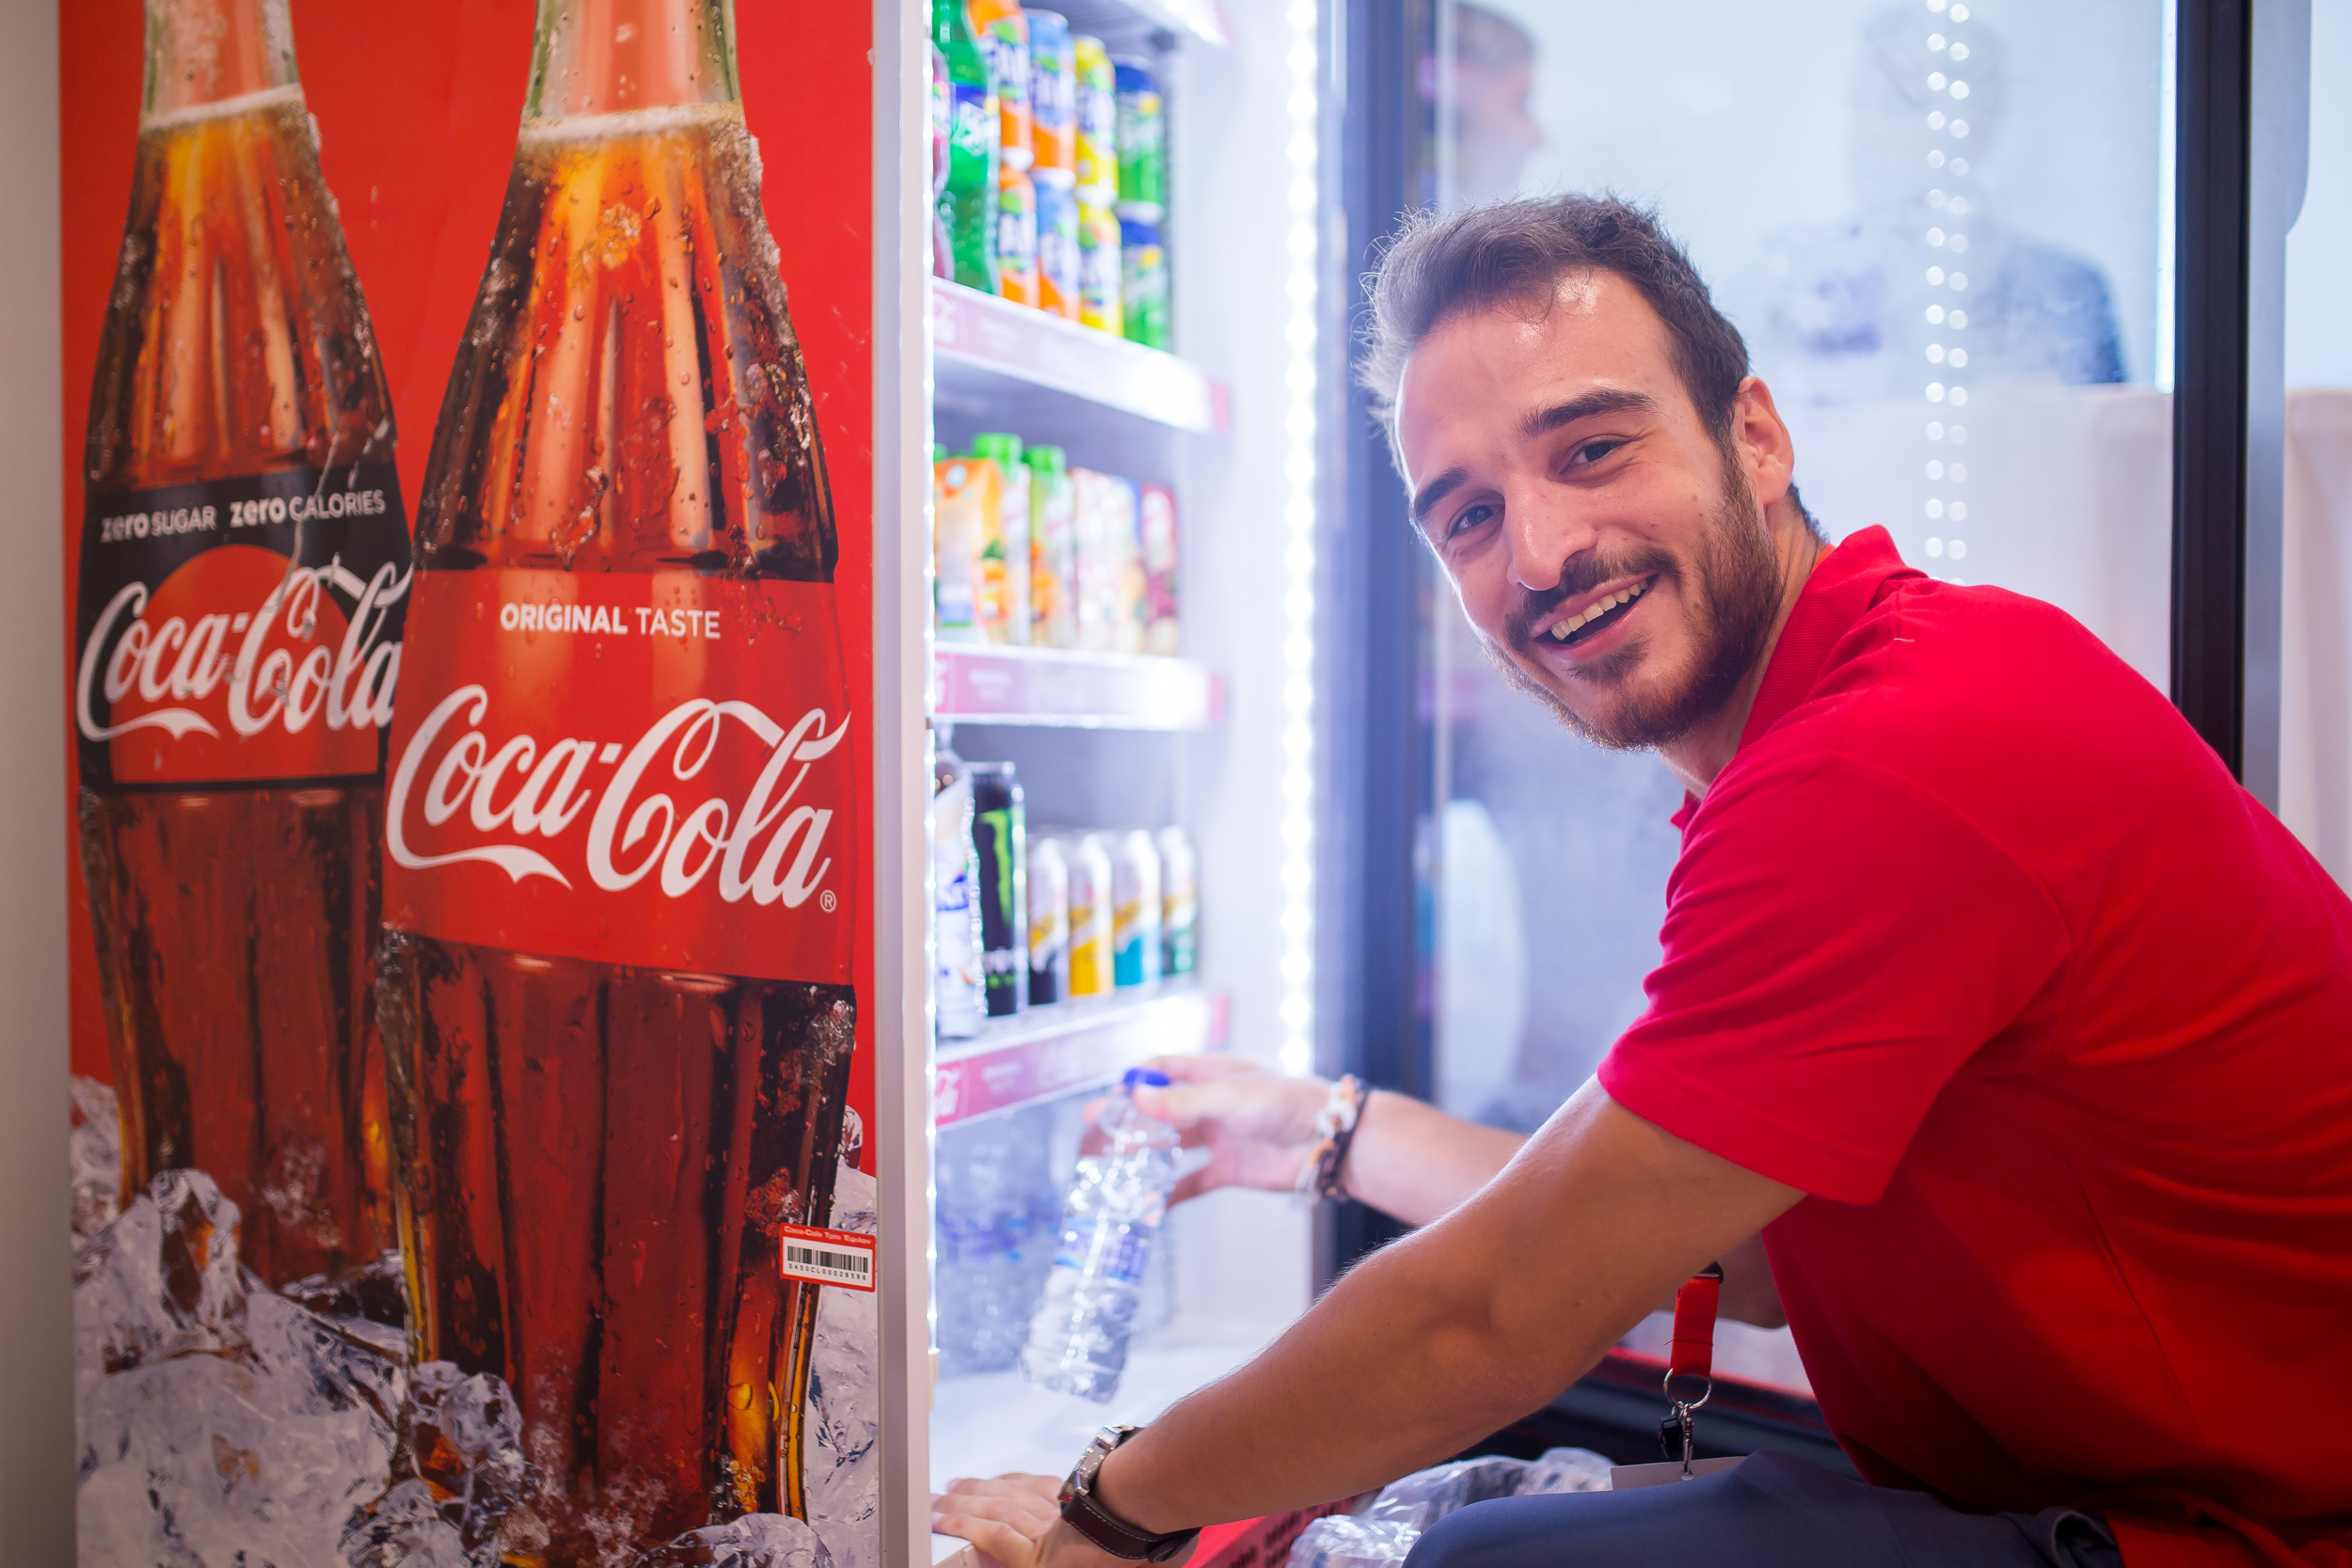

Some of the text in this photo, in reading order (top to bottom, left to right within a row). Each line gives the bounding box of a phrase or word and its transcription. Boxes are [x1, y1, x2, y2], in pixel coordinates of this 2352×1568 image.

[77, 562, 414, 741] Coca-Cola
[500, 602, 722, 640] ORIGINAL TASTE
[386, 684, 851, 909] Coca-Cola
